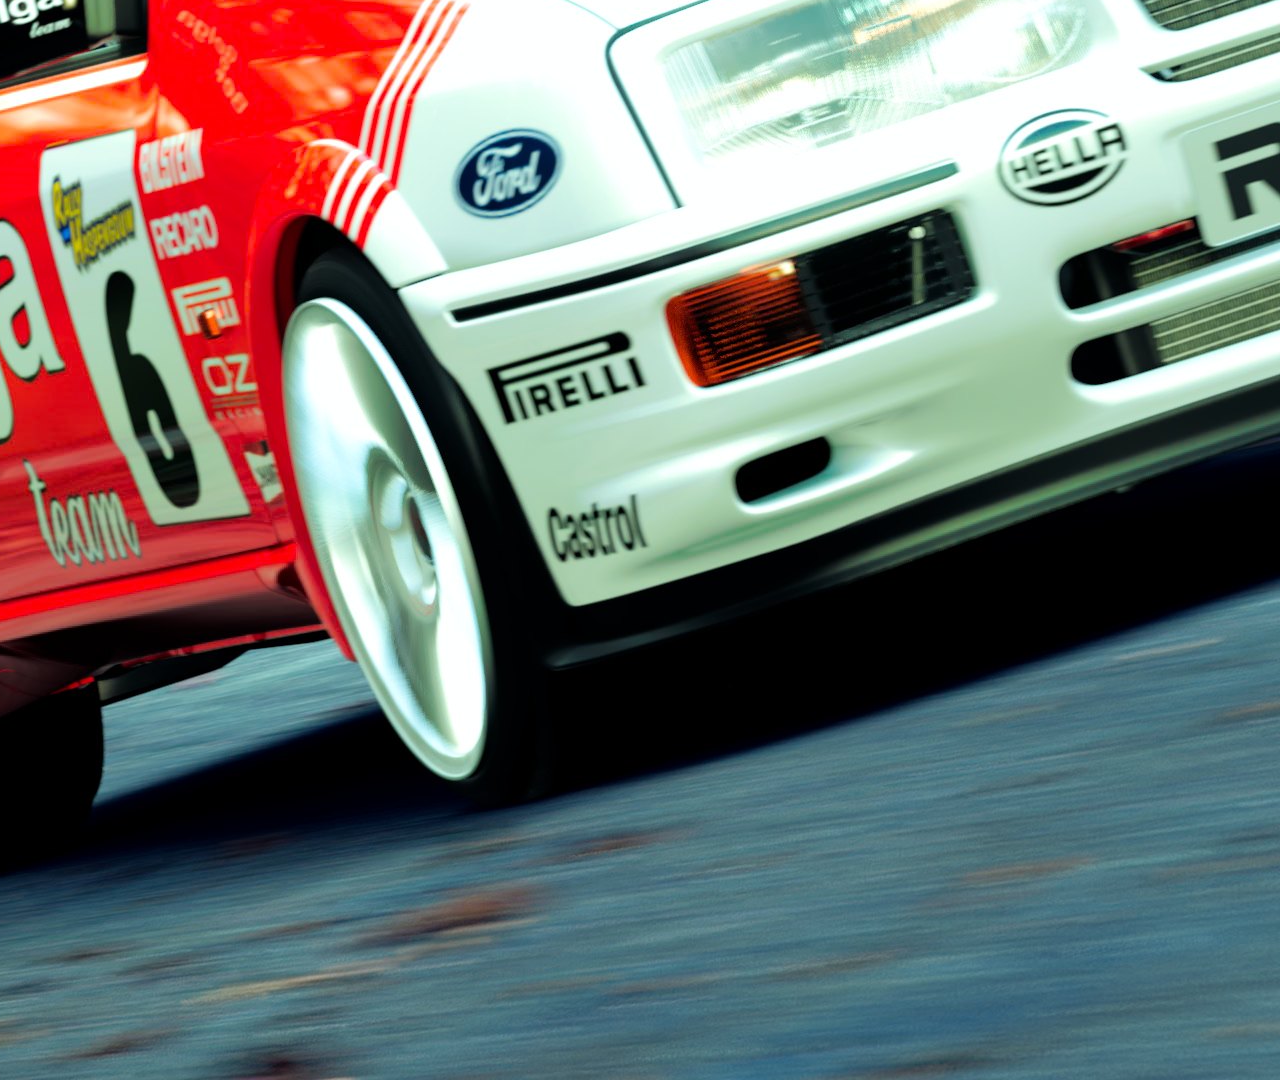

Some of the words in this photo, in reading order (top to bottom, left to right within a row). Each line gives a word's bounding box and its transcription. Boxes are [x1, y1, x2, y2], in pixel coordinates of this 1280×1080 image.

[29, 17, 71, 38] team
[139, 128, 205, 194] BILSTEIN
[471, 140, 541, 207] Ford
[1008, 123, 1127, 183] HELLA
[150, 205, 219, 260] RECARO
[105, 270, 200, 508] 6
[202, 354, 258, 396] OZ
[486, 331, 647, 425] PIRELLI
[23, 458, 141, 568] team
[546, 493, 648, 563] Castrol
